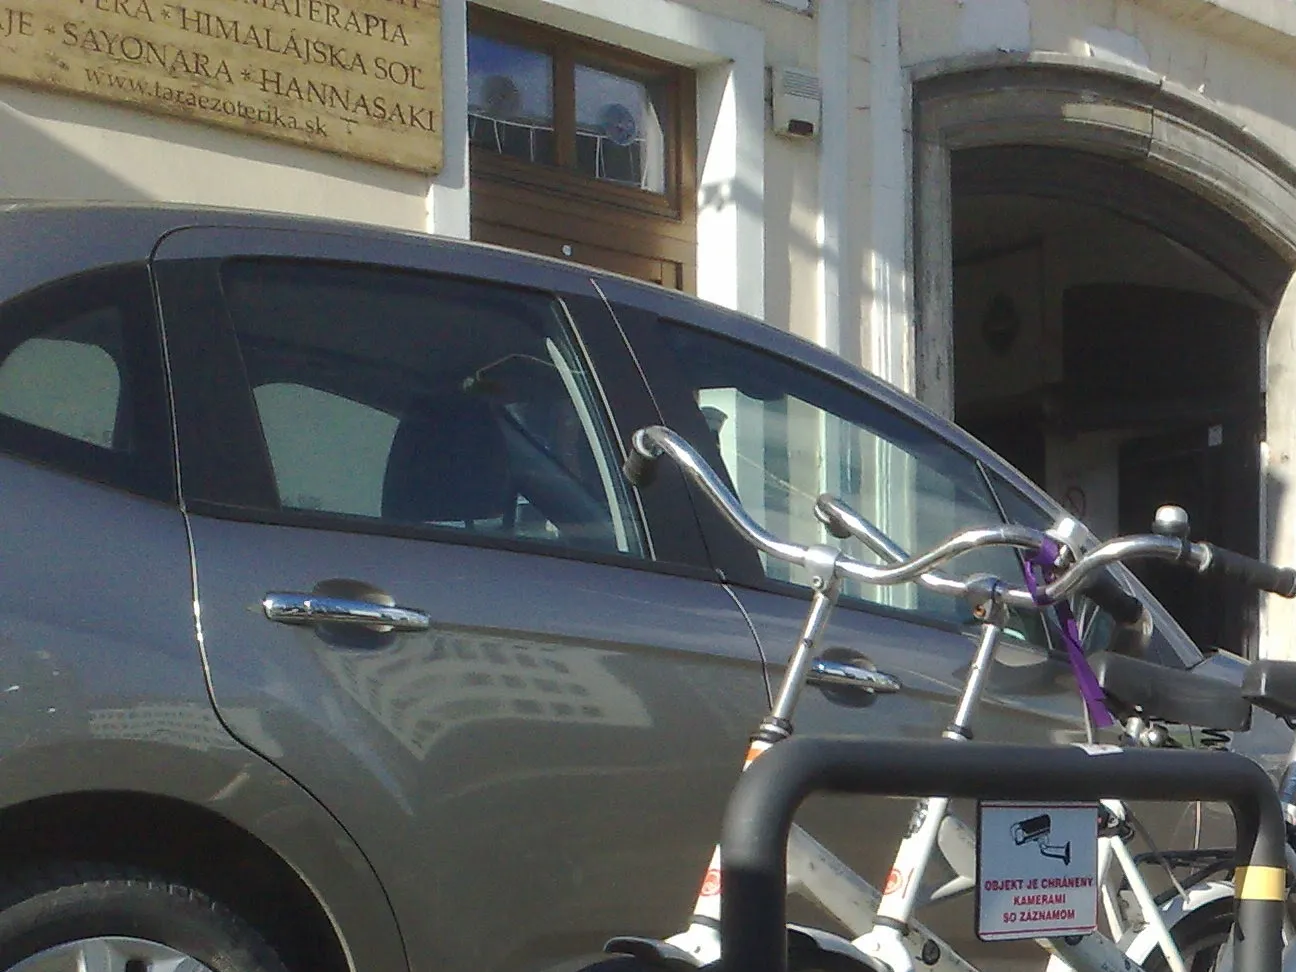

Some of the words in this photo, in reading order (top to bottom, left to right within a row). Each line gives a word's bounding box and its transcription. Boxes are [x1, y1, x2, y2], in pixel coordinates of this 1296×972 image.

[181, 7, 367, 75] HIMALÁJSKA
[0, 8, 34, 38] JE
[62, 21, 235, 85] SAYONARA
[260, 68, 437, 133] HANNASAKI
[984, 879, 1024, 891] OBJEKT
[1026, 878, 1039, 889] JE
[1013, 893, 1067, 906] KAMERAMI
[1003, 911, 1018, 923] SO
